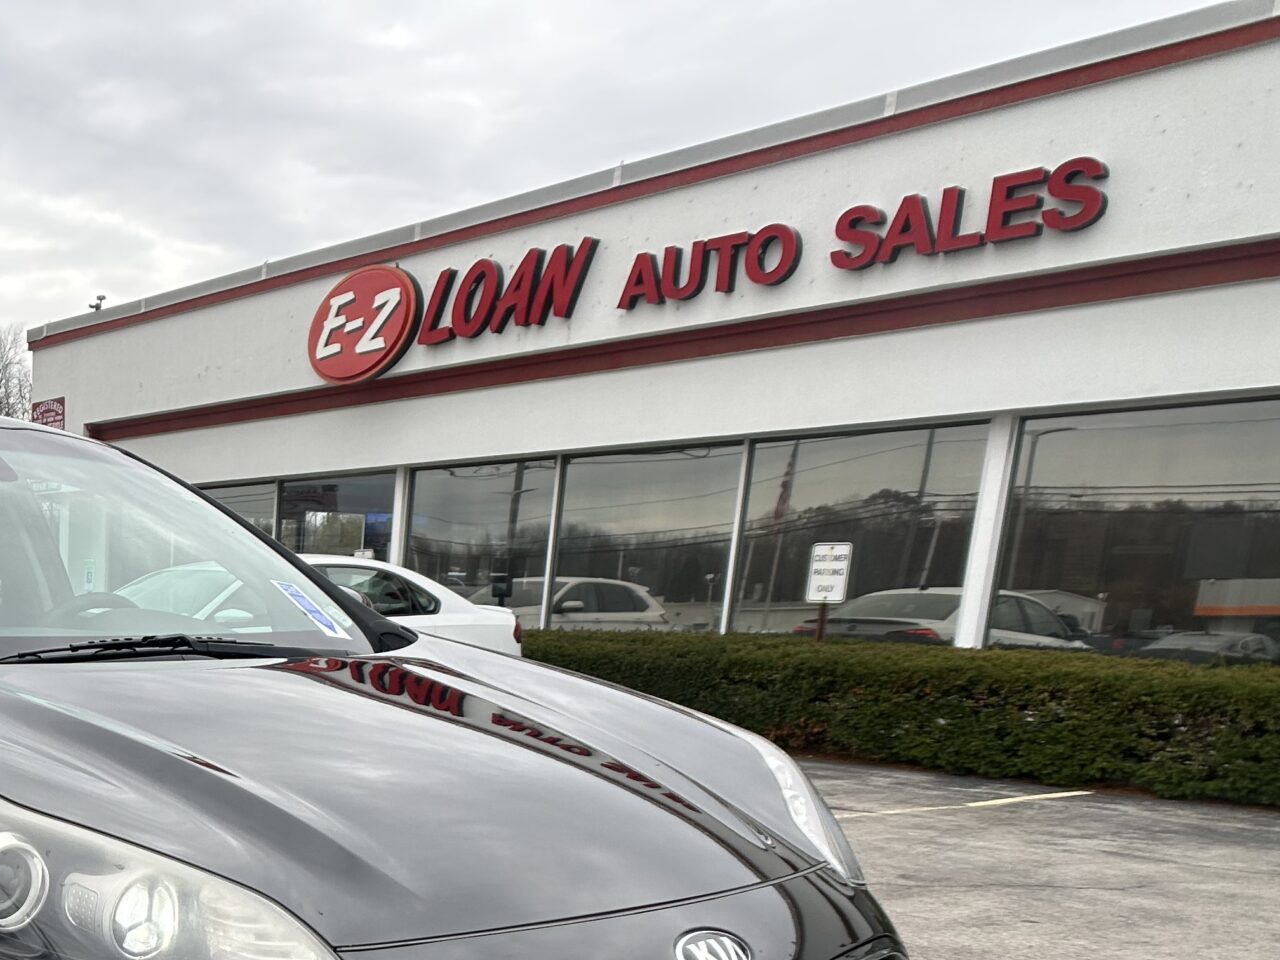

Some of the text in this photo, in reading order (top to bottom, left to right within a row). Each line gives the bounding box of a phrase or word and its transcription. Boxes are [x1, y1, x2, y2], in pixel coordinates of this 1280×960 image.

[316, 157, 1108, 360] E-Z LOAN AUTO SALES
[33, 400, 63, 419] REGISTERED
